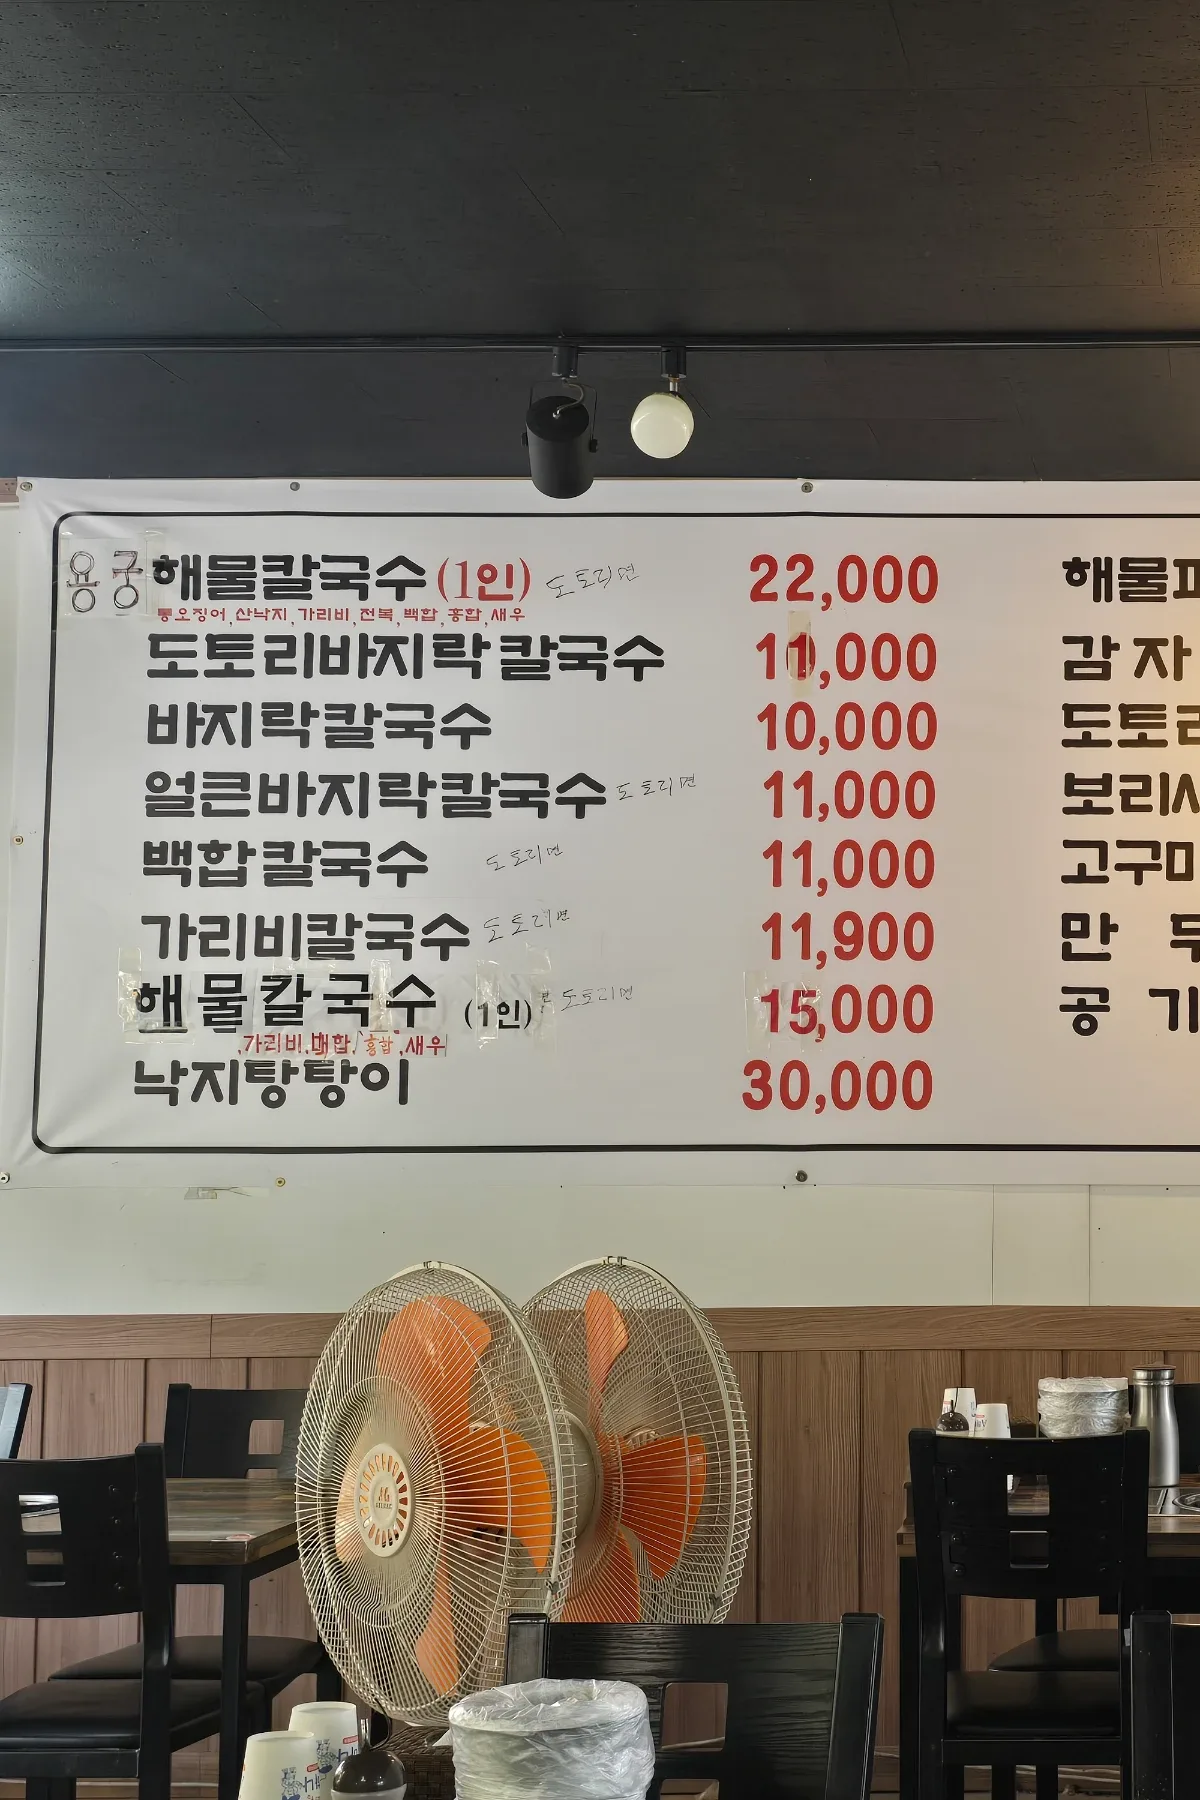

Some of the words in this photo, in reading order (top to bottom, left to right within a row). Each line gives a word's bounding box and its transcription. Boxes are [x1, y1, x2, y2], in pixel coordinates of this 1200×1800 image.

[152, 553, 428, 603] 해물칼국수
[436, 556, 533, 603] (1인)
[750, 554, 938, 611] 22,000
[148, 702, 491, 750] 바지락칼국수
[757, 701, 937, 755] 10,000
[145, 771, 606, 819] 얼큰바지락칼국수
[764, 770, 935, 822] 11,000
[143, 840, 428, 888] 백합칼국수
[763, 839, 934, 897] 11,000
[141, 913, 470, 961] 가리비칼국수
[762, 911, 934, 970] 11,900
[463, 998, 533, 1031] (1인)
[760, 982, 935, 1044] 15,000
[134, 1059, 410, 1108] 낙지탕탕이
[742, 1060, 932, 1114] 30,000
